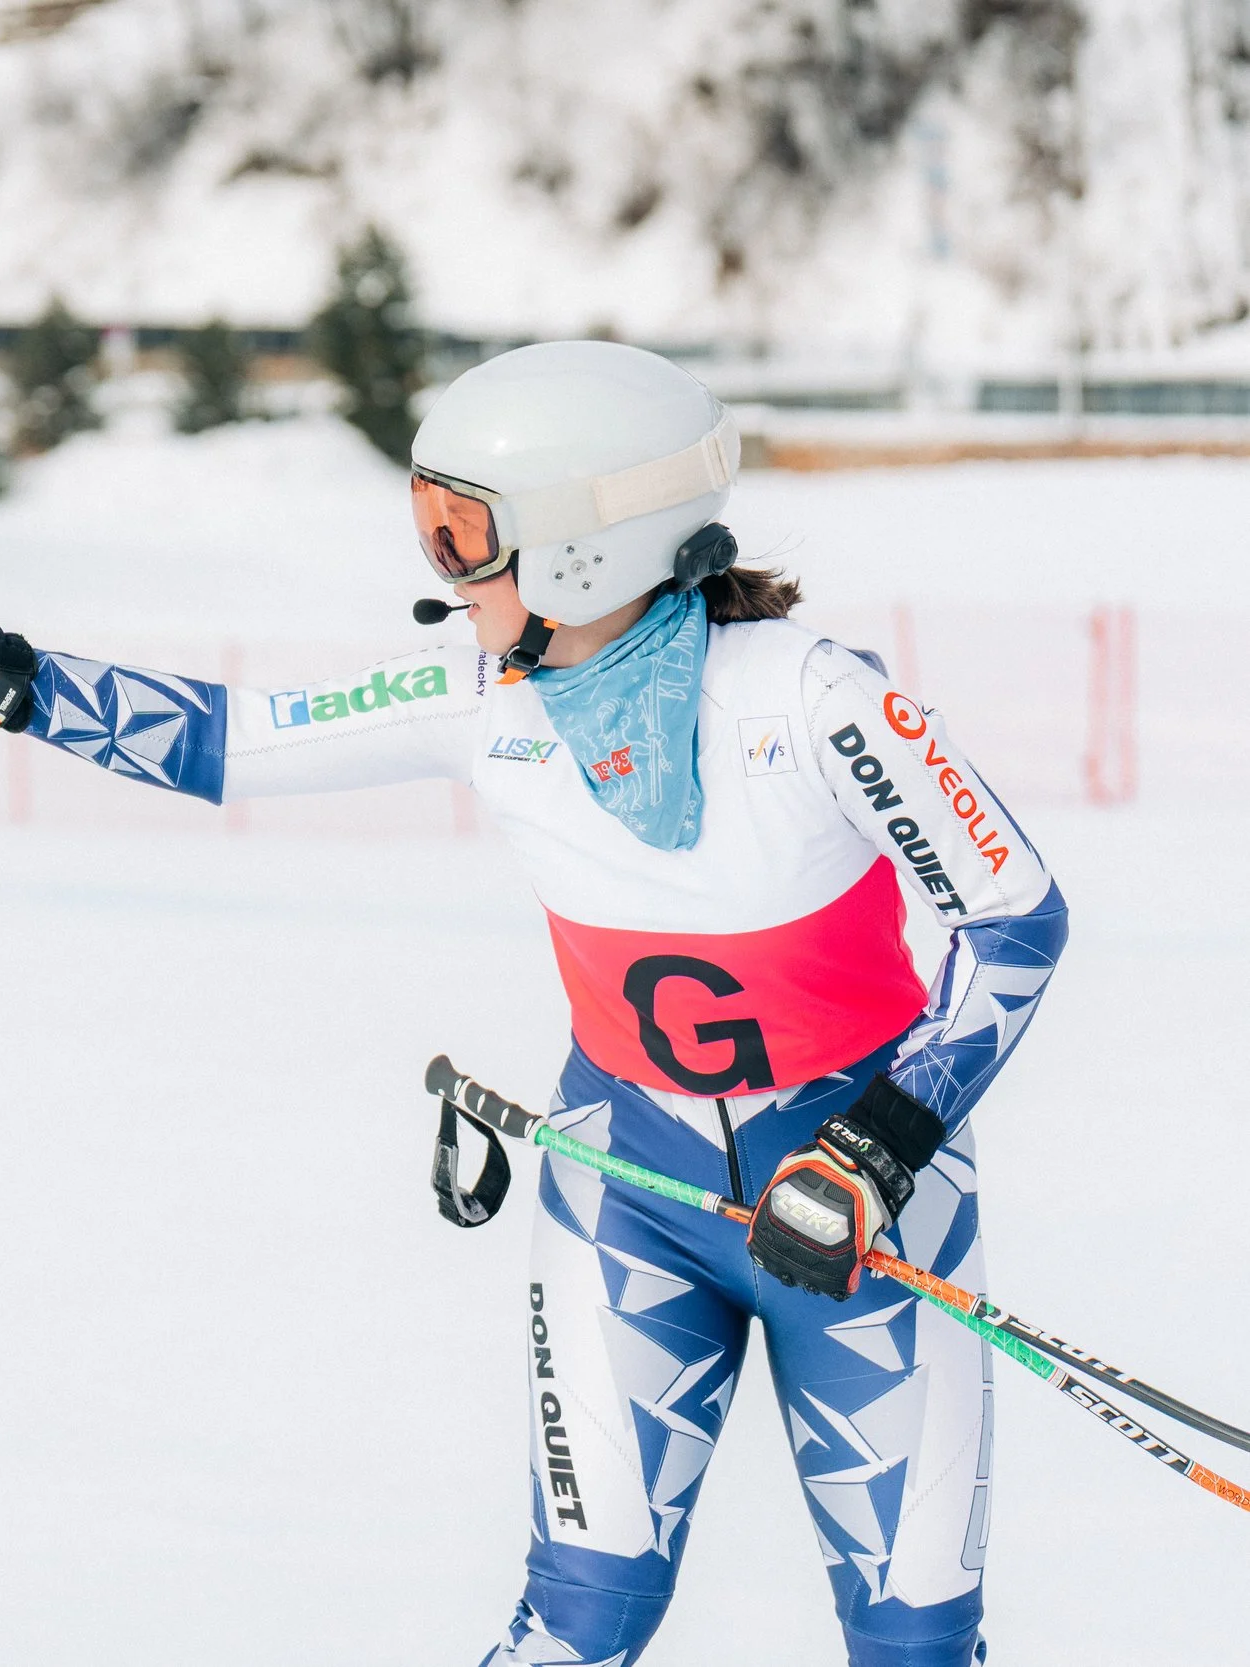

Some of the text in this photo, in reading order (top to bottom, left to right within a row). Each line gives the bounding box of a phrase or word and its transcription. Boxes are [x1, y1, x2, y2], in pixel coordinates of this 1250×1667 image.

[269, 665, 449, 730] radka
[490, 736, 559, 759] LISKI
[612, 752, 631, 772] 49
[828, 722, 968, 916] DON QUIET
[925, 738, 1010, 876] VEOLIA
[622, 954, 775, 1095] G
[776, 1193, 840, 1236] LEKI
[530, 1282, 588, 1531] DON QUIET
[1064, 1384, 1190, 1466] SCOTT
